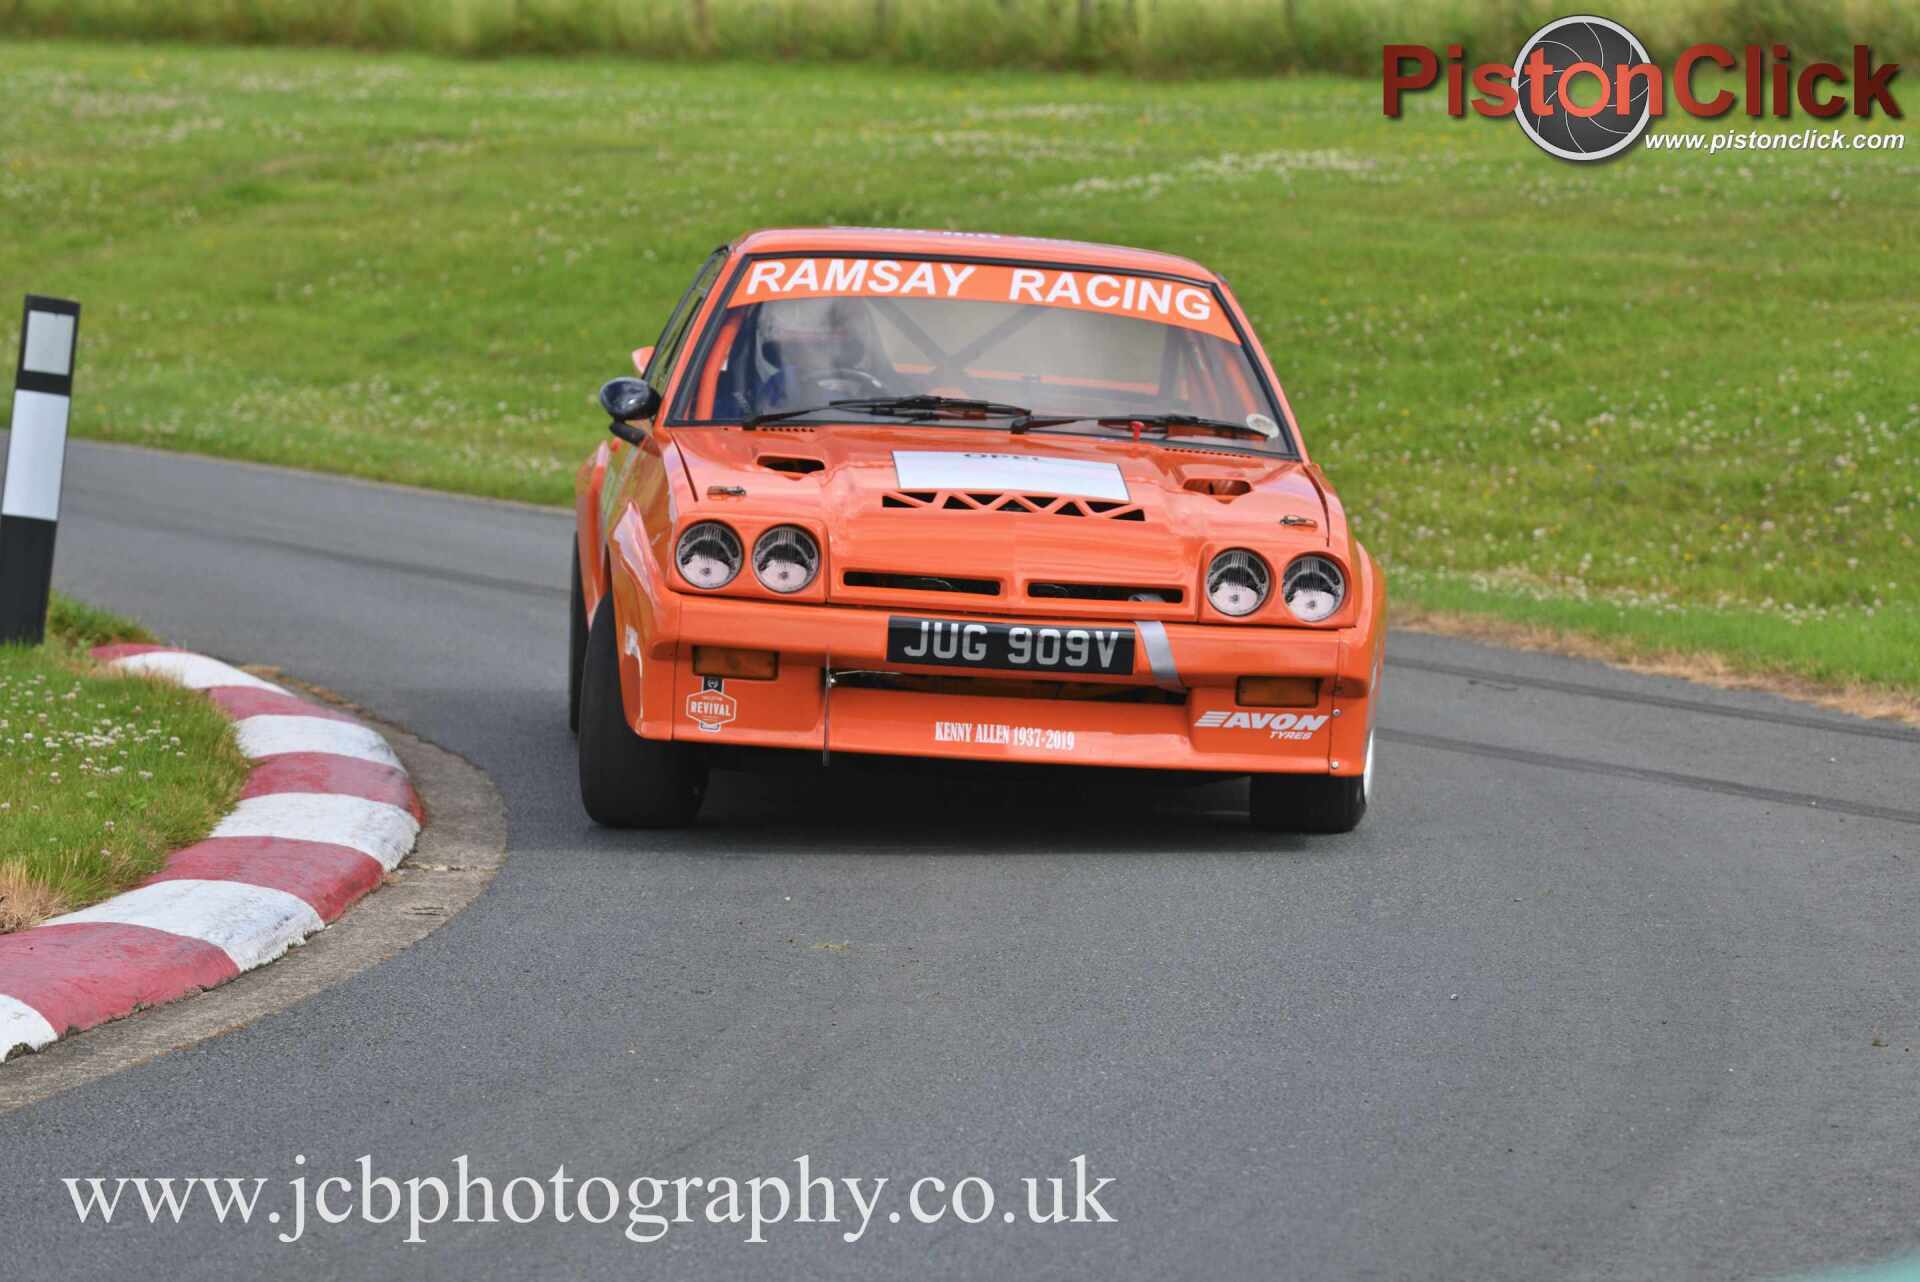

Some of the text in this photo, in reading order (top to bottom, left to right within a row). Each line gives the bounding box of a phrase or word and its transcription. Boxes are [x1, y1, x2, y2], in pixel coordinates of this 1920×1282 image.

[746, 258, 1212, 321] RAMSAY RACING
[903, 621, 1119, 668] JUG 909V
[690, 701, 731, 717] REVIVAL
[1222, 711, 1329, 731] AVON
[935, 721, 1075, 751] KENNY ALLEN 1937-2019
[1269, 731, 1313, 740] TYRES
